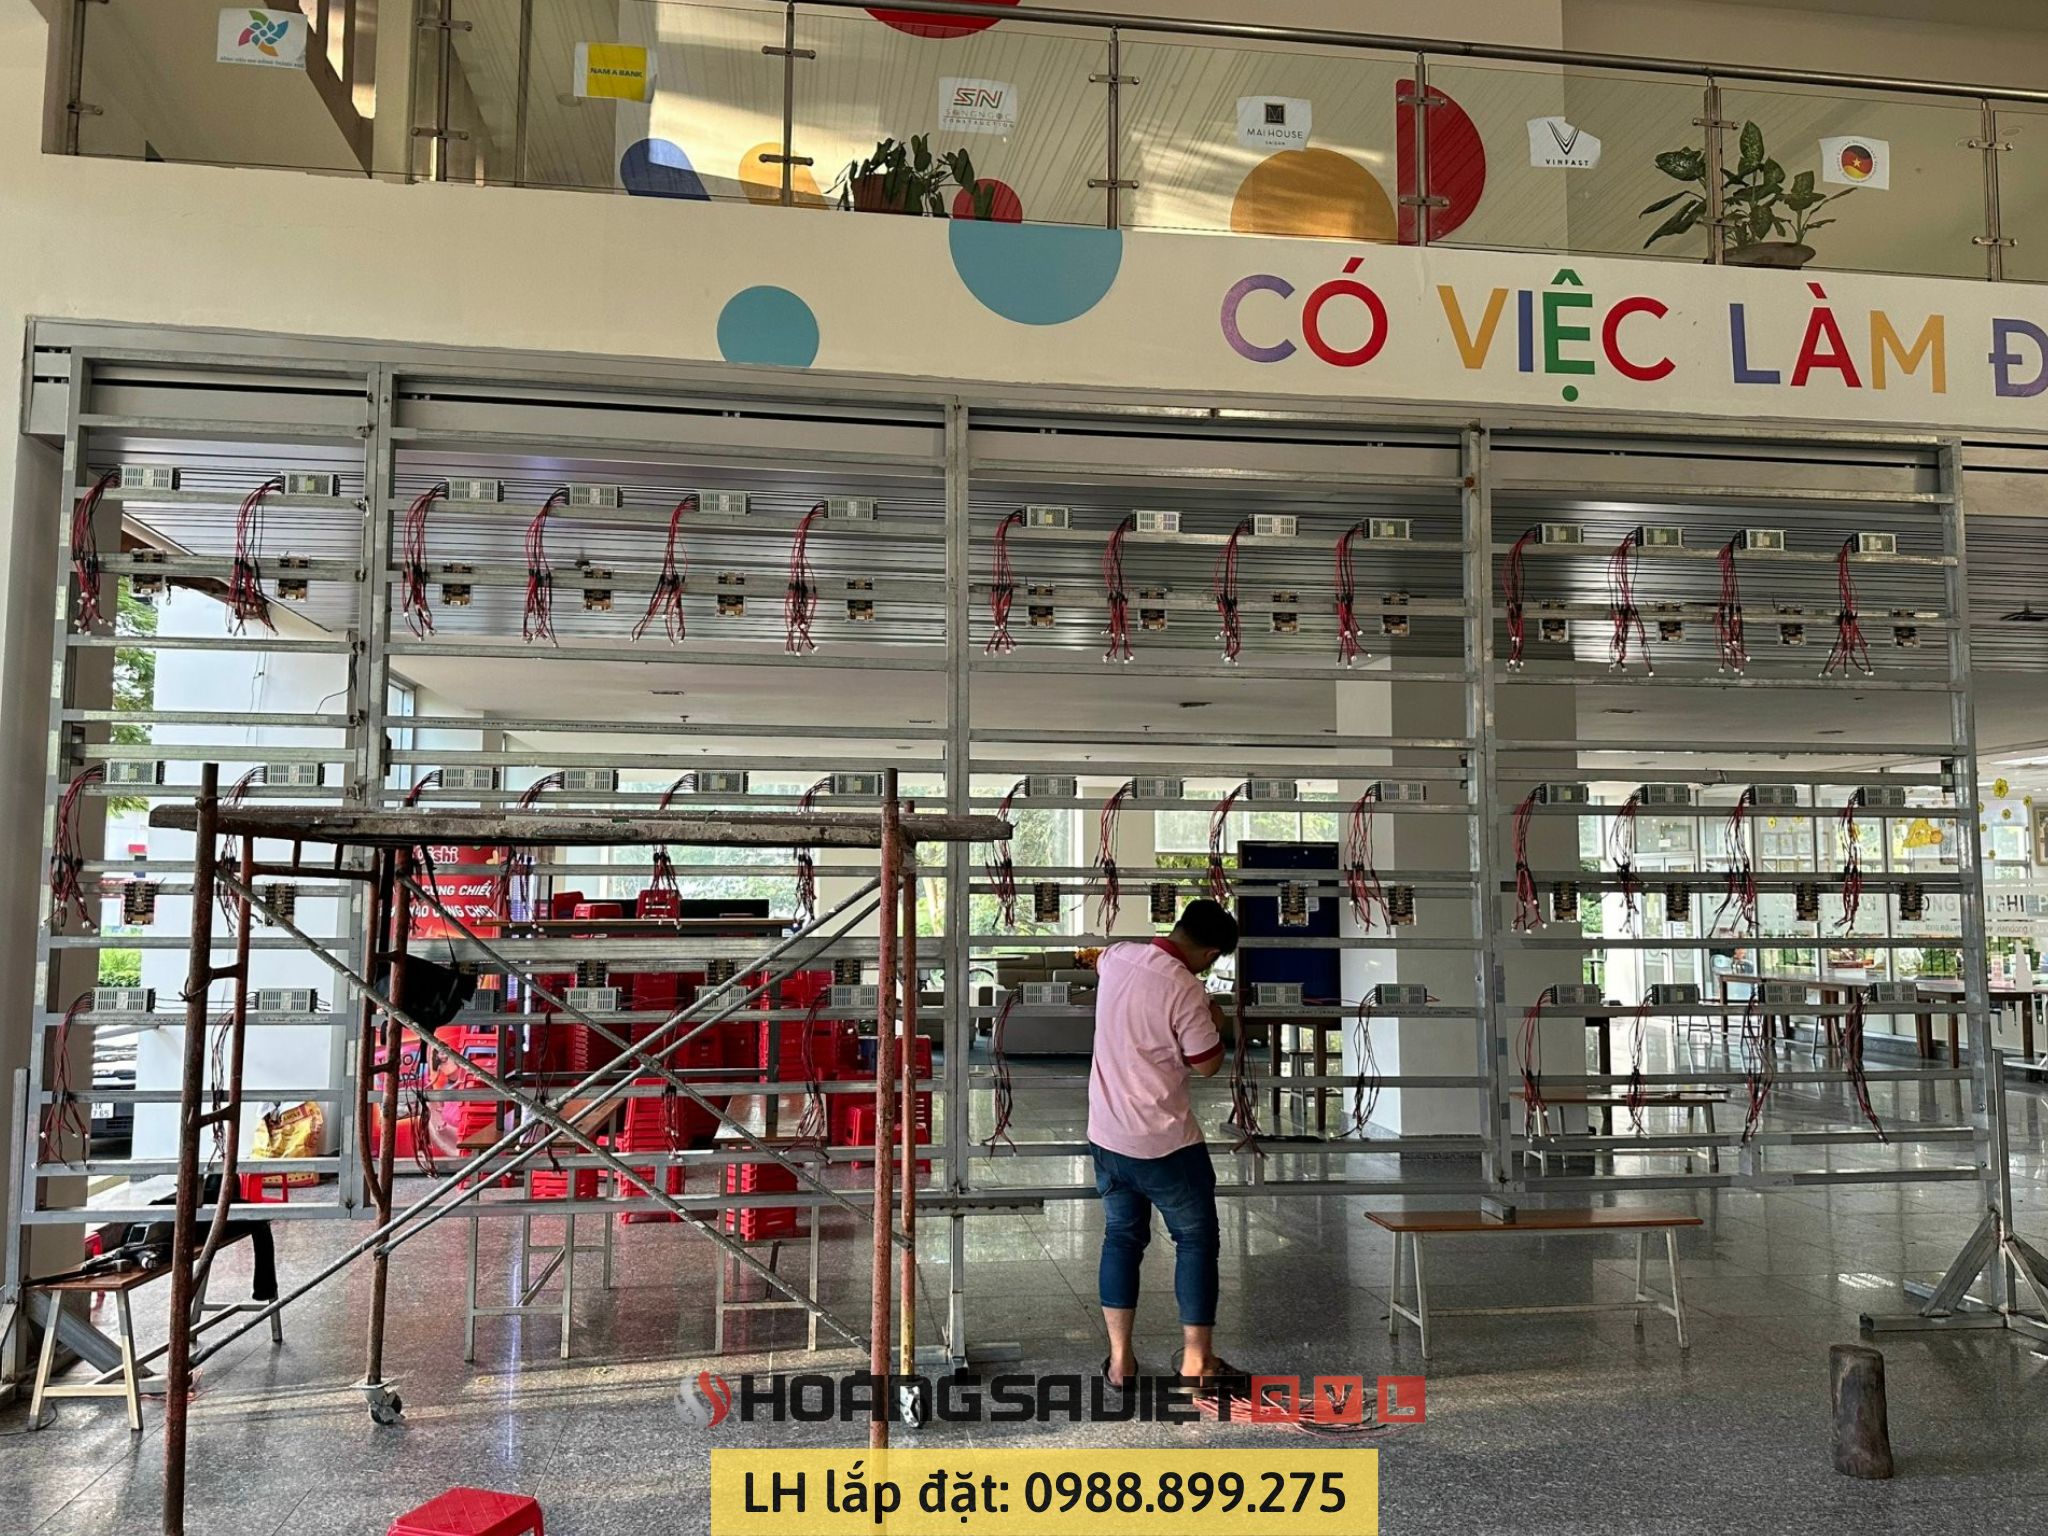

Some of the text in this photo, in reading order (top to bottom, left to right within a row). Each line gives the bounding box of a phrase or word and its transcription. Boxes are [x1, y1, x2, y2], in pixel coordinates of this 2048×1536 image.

[1268, 129, 1303, 139] HOUSE
[1220, 257, 1388, 367] CÓ
[1436, 269, 1676, 402] VIỆC
[1729, 282, 1946, 394] LÀM
